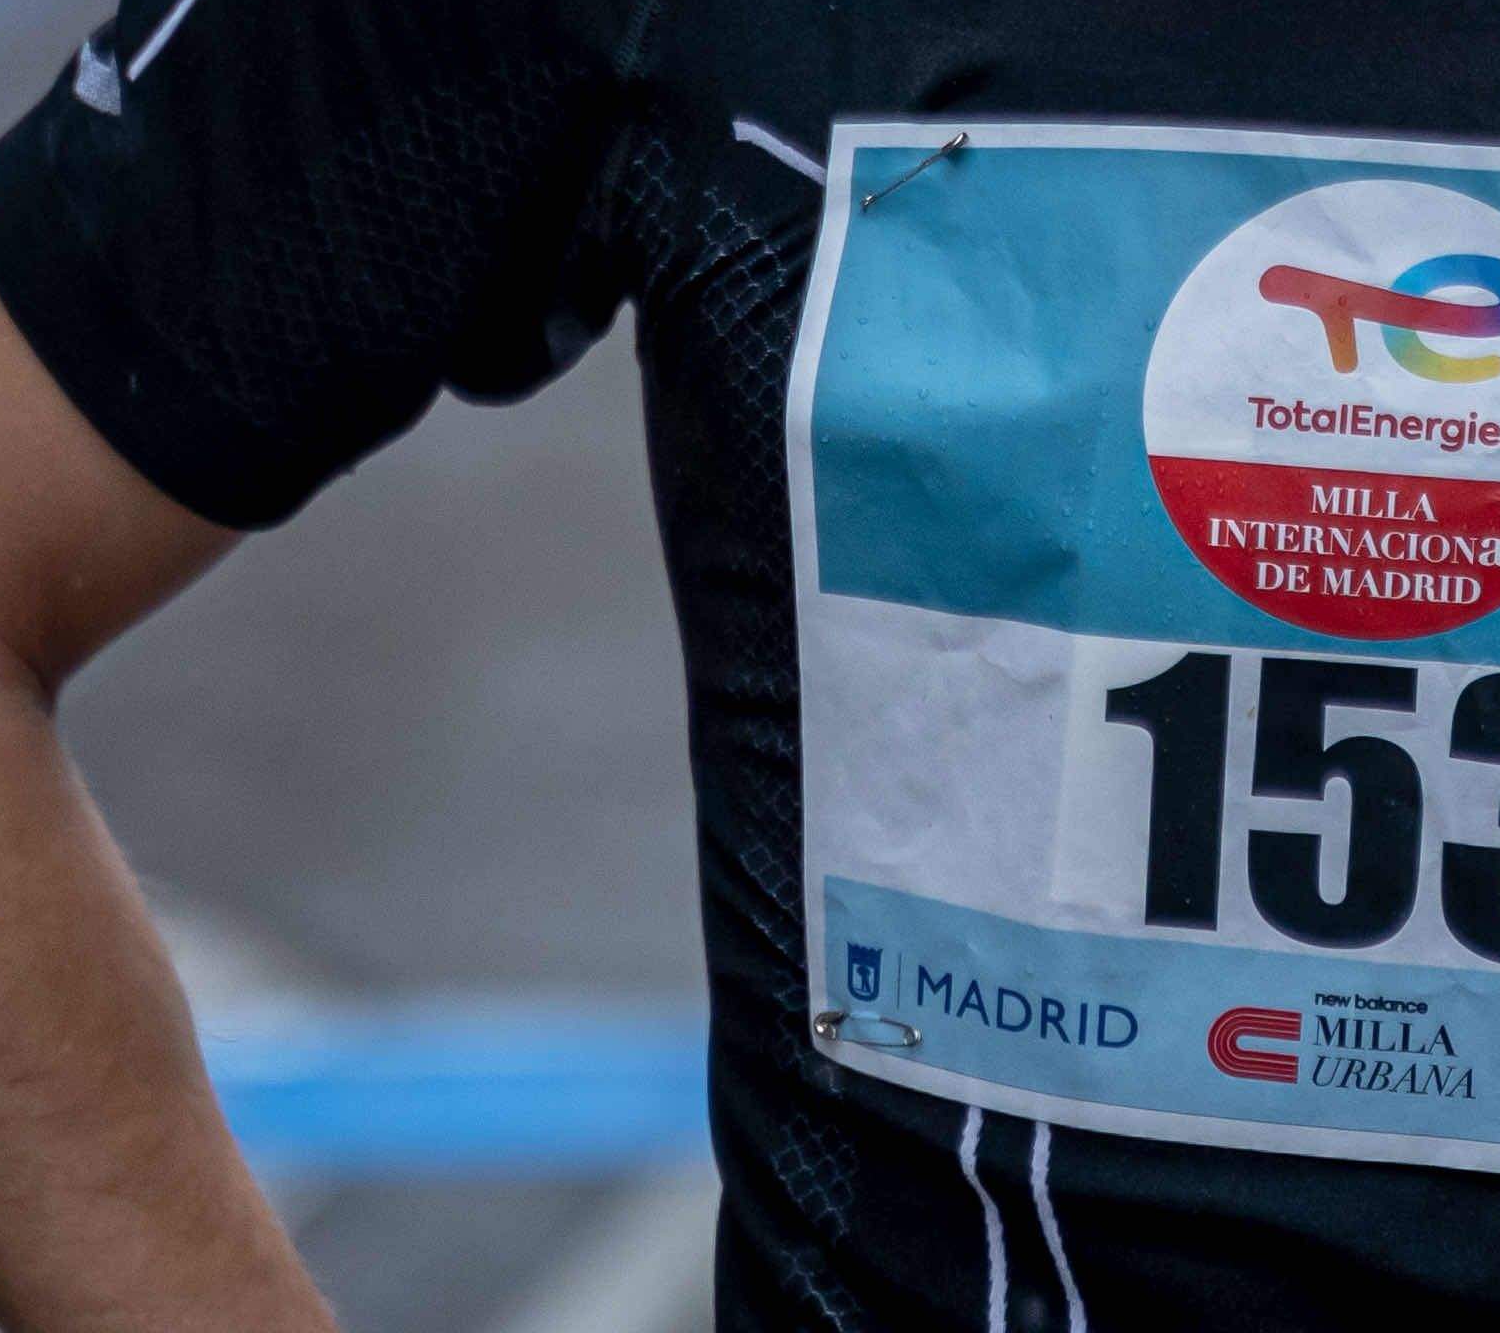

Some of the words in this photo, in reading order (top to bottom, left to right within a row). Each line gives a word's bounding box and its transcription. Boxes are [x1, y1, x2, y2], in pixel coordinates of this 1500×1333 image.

[1311, 484, 1438, 523] MILLA
[1256, 562, 1310, 593] DE
[1321, 568, 1482, 604] MADRID
[917, 965, 1138, 1048] MADRID
[1315, 992, 1350, 1006] new
[1355, 994, 1428, 1014] balance
[1313, 1015, 1458, 1057] MILLA
[1312, 1055, 1476, 1099] URBANA
